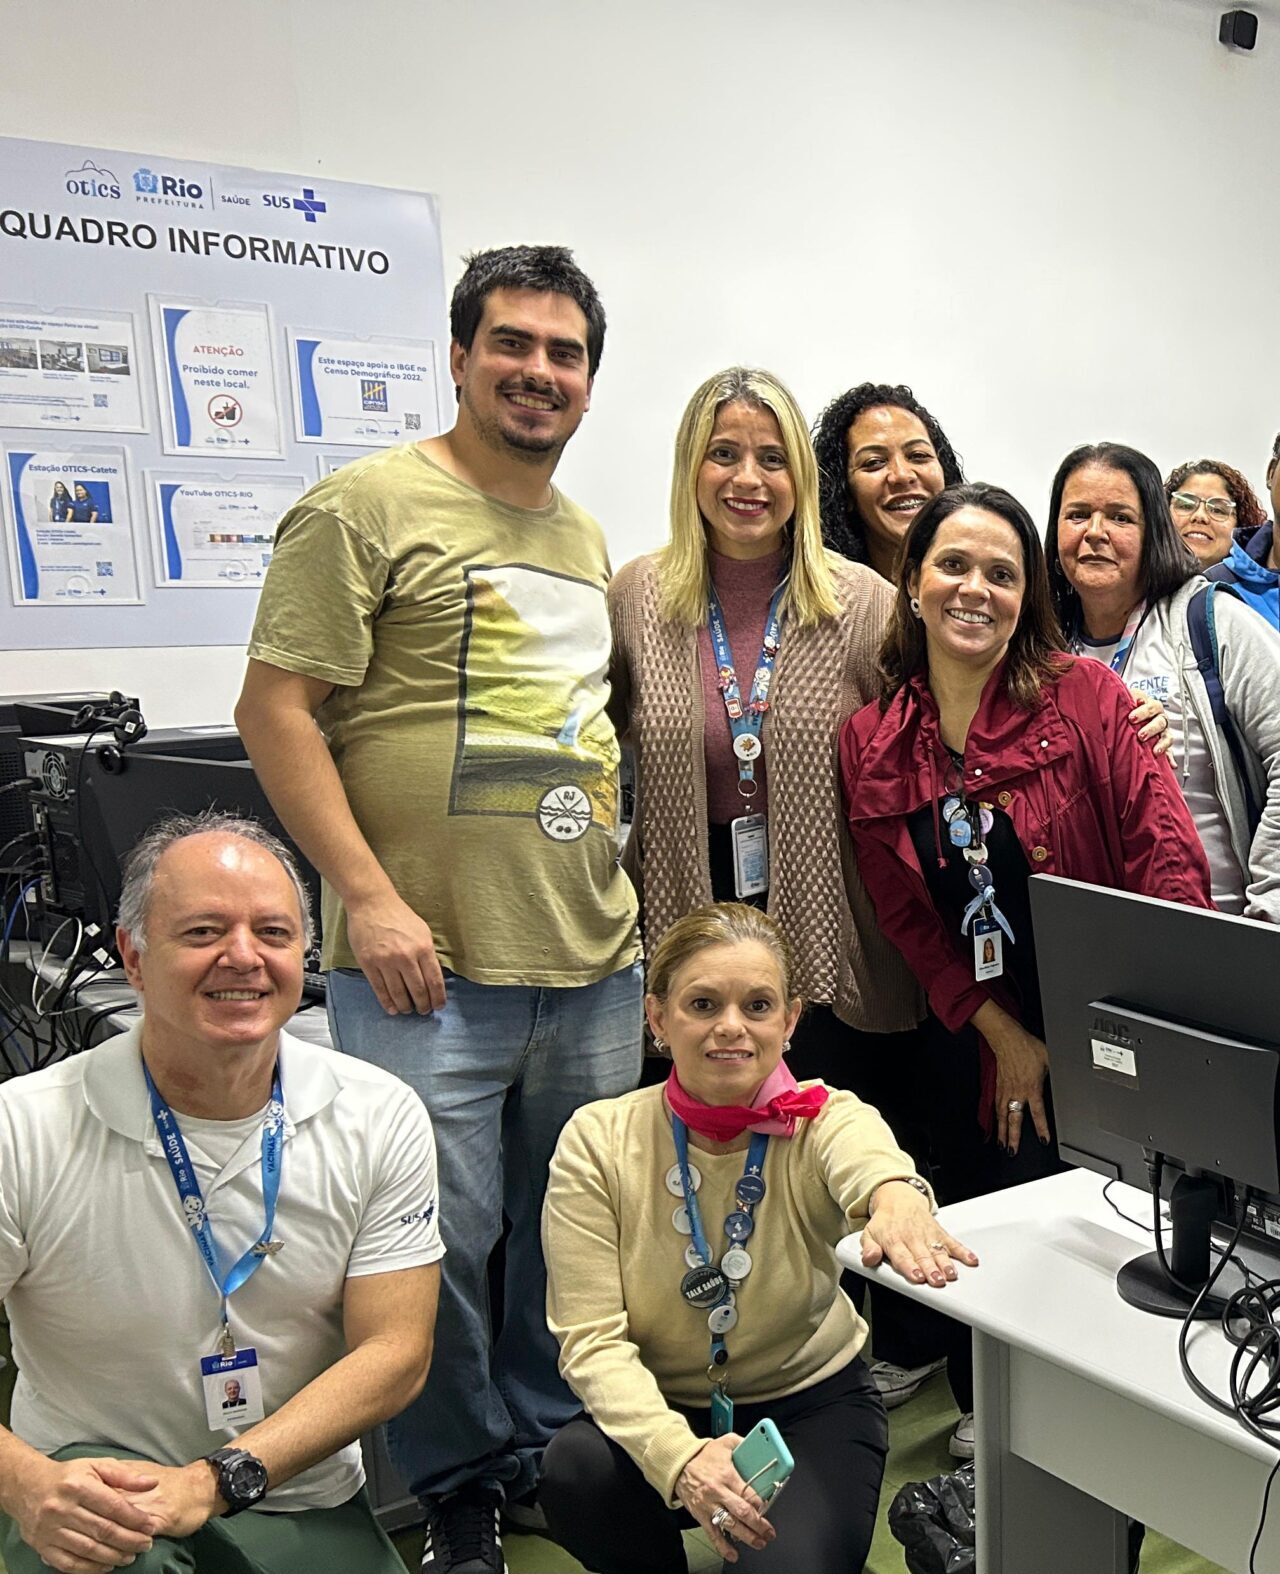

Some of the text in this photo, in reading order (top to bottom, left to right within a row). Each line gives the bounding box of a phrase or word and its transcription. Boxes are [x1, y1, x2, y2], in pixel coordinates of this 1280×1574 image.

[66, 179, 120, 200] otics
[161, 175, 204, 199] Rio
[136, 195, 204, 210] PREFEITURA
[221, 194, 251, 206] SAÚDE
[262, 194, 292, 209] SUS
[0, 209, 390, 275] QUADRO INFORMATIVO
[193, 345, 244, 357] ATENÇÃO
[182, 364, 258, 377] Proibido comer
[318, 356, 336, 365] Este
[337, 360, 364, 369] espaço
[366, 361, 388, 371] apoia
[324, 366, 349, 376] Censo
[350, 369, 401, 380] Demográfico
[193, 379, 250, 389] neste local.
[28, 464, 61, 473] Estação
[180, 489, 213, 497] YouTube
[713, 619, 724, 643] SAÚDE
[1130, 675, 1170, 690] GENTE
[563, 791, 576, 801] RJ
[166, 1132, 184, 1165] SAÚDE
[267, 1136, 276, 1174] VACINAS
[400, 1212, 423, 1226] SUS
[685, 1285, 703, 1299] TALK
[701, 1275, 724, 1292] SAÚDE
[220, 1360, 233, 1368] Rio
